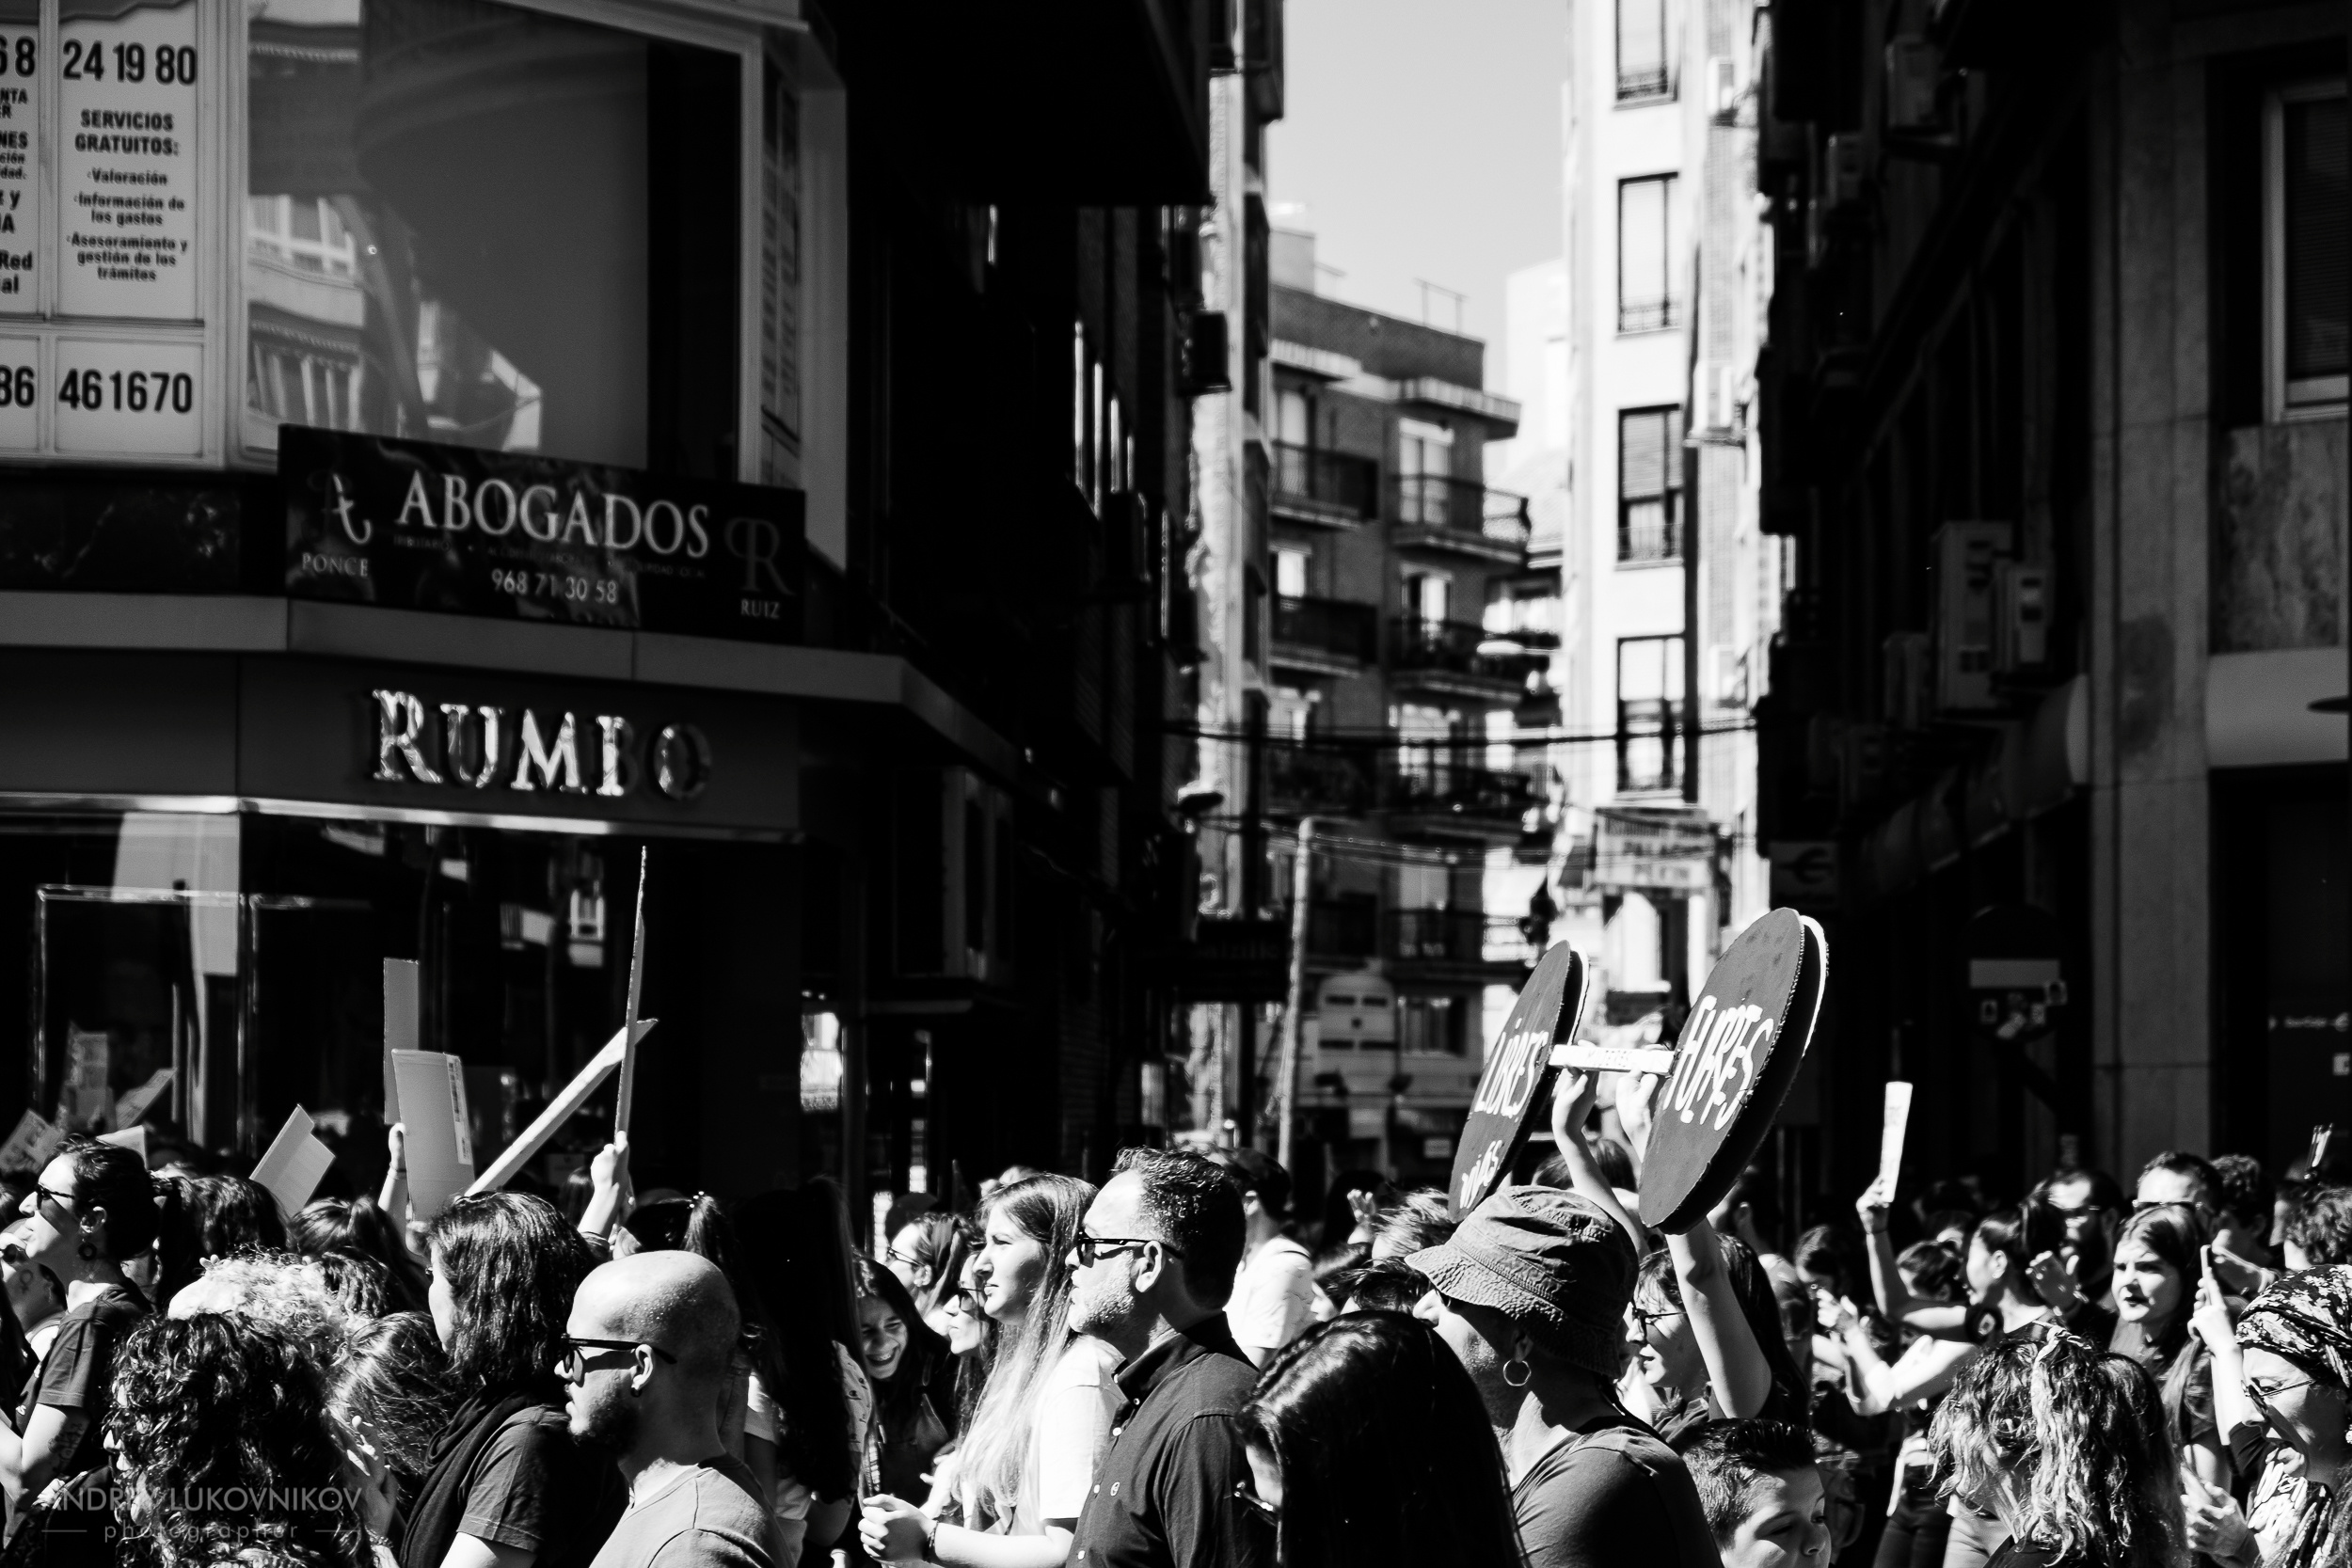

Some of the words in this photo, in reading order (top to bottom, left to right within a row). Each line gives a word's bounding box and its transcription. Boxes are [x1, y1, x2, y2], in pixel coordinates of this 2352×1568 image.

[81, 108, 174, 132] SERVICIOS
[74, 133, 180, 157] GRATUITOS:
[167, 195, 185, 212] de
[91, 208, 112, 224] los
[116, 211, 164, 228] gastos
[77, 248, 130, 267] gestión
[134, 250, 151, 267] de
[155, 249, 177, 267] los
[180, 239, 188, 256] y
[97, 265, 157, 281] trámites
[393, 468, 711, 561] ABOGADOS
[301, 550, 369, 578] PONCE
[491, 567, 530, 595] 968
[533, 572, 558, 598] 71
[564, 575, 589, 602] 30
[594, 578, 619, 605] 58
[739, 597, 781, 620] RUIZ
[373, 689, 713, 802] RUMBO
